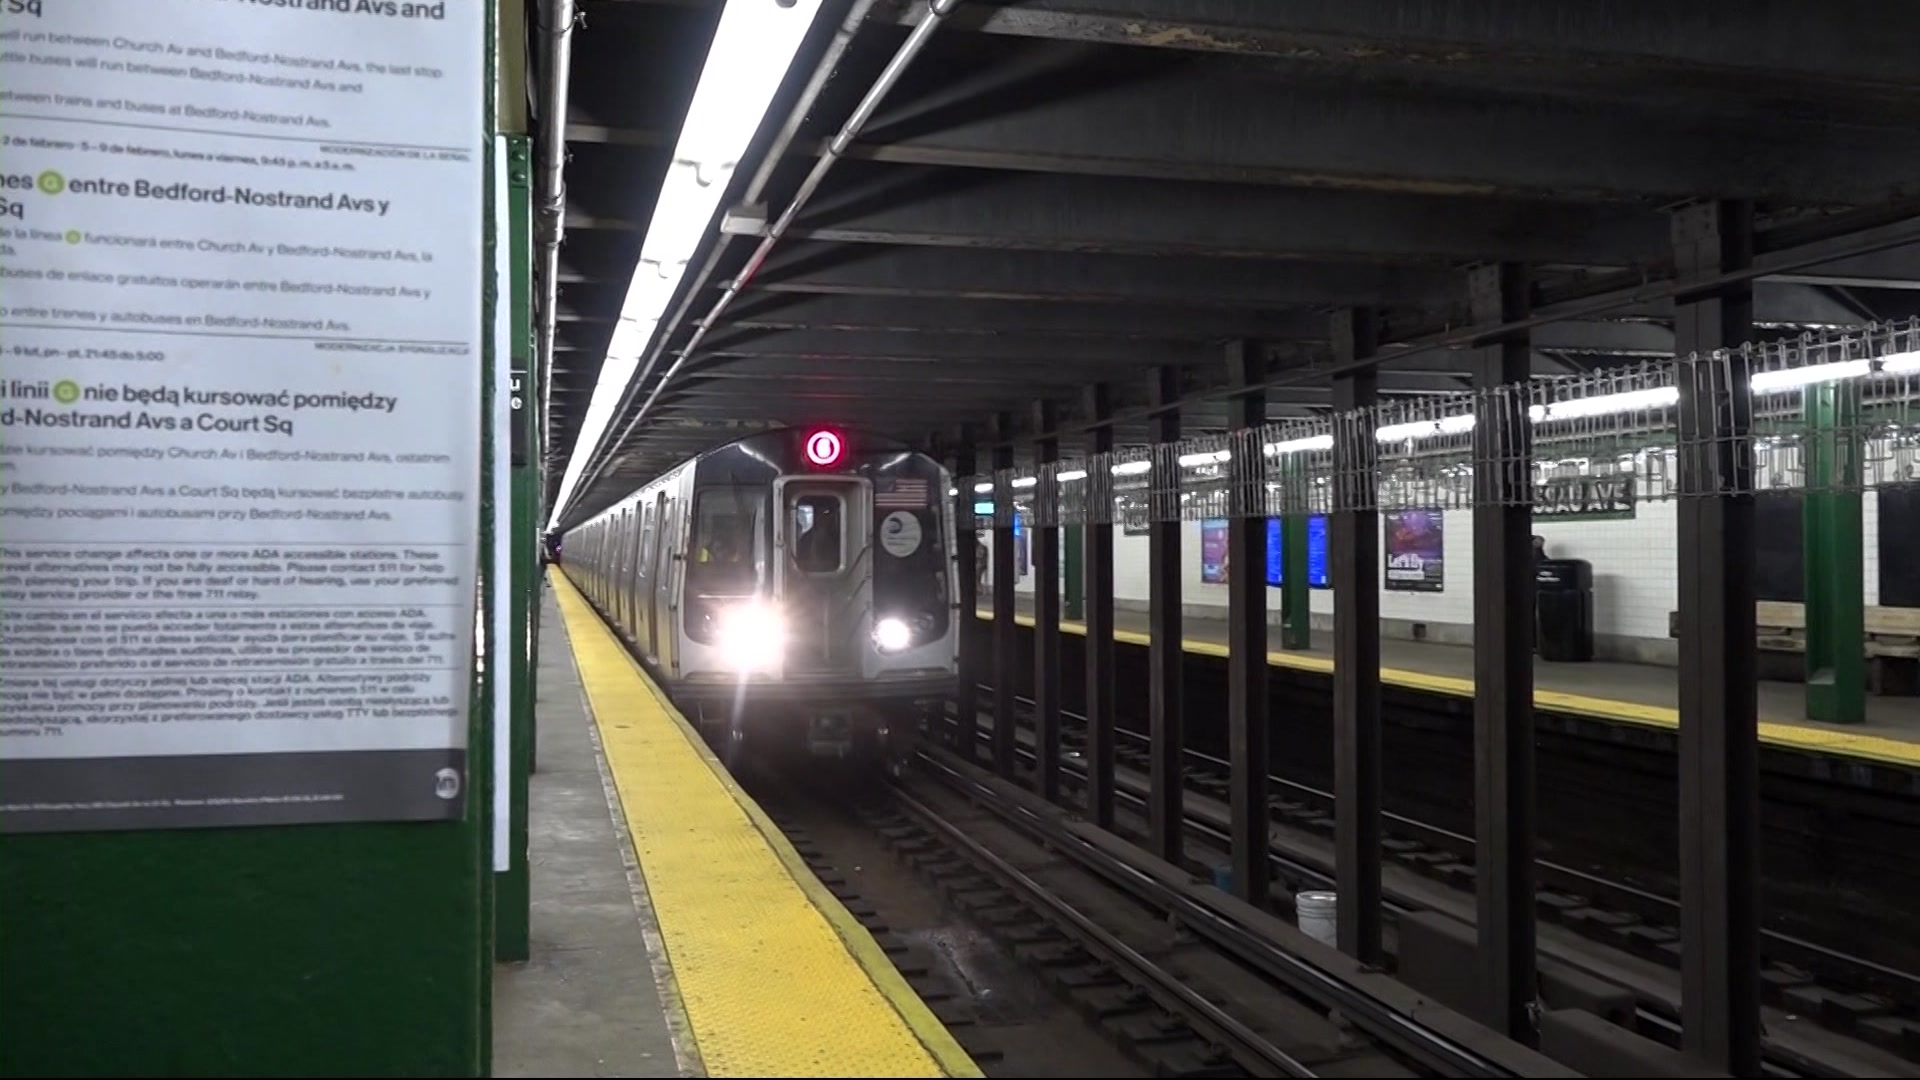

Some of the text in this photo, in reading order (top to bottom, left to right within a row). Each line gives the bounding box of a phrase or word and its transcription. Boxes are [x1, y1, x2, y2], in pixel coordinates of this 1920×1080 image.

[8, 0, 43, 18] Sq
[355, 0, 397, 17] Avs
[400, 1, 445, 20] and
[23, 32, 46, 42] run
[48, 32, 110, 48] between
[113, 37, 164, 53] Church
[167, 44, 184, 55] Av
[187, 47, 213, 58] and
[215, 47, 334, 71] Bedford-Nostrand
[366, 62, 387, 74] the
[389, 64, 411, 75] last
[414, 65, 444, 79] stop
[29, 54, 363, 93] buses will run between Bedford-Nostrand Avs and
[55, 94, 93, 107] trains
[96, 98, 122, 110] and
[125, 100, 165, 114] buses
[168, 105, 182, 115] at
[184, 104, 303, 127] Bedford-Nostrand
[0, 174, 33, 191] es
[69, 178, 130, 197] entre
[134, 179, 334, 211] Bedford-Nostrand
[336, 194, 374, 213] Avs
[378, 200, 390, 216] y
[15, 229, 27, 239] la
[30, 229, 62, 242] línea
[84, 233, 157, 248] funcionará
[159, 240, 194, 251] entre
[197, 239, 245, 254] Church
[248, 244, 264, 254] Av
[267, 247, 273, 256] y
[277, 244, 391, 261] Bedford-Nostrand
[421, 251, 432, 263] la
[46, 269, 431, 300] de enlace gratuitos operarán entre Bedford-Nostrand Avs y
[11, 307, 48, 319] entre
[52, 308, 96, 321] trenes
[99, 313, 106, 323] y
[110, 312, 182, 325] autobuses
[186, 316, 201, 326] en
[205, 315, 323, 331] Bedford-Nostrand
[11, 380, 49, 400] linii
[84, 383, 118, 402] nie
[123, 384, 179, 407] będą
[184, 386, 290, 407] kursować
[294, 391, 397, 413] pomiędzy
[0, 407, 293, 437] d-Nostrand Avs a Court Sq
[26, 445, 93, 457] kursować
[97, 447, 163, 460] pomiędzy
[167, 447, 217, 459] Church
[220, 449, 237, 460] Av
[247, 449, 363, 463] Bedford-Nostrand
[395, 454, 450, 464] ostatnim
[11, 482, 464, 501] Bedford-Nostrand Avs a Court Sq będą kursować bezpłatne autobusy
[57, 507, 128, 519] pociągami
[137, 508, 215, 518] autobusami
[217, 511, 246, 521] przy
[249, 508, 366, 520] Bedford-Nostrand
[26, 550, 71, 559] service
[74, 551, 122, 561] change
[126, 549, 169, 559] affects
[173, 551, 196, 559] one
[200, 551, 213, 559] or
[216, 551, 249, 560] more
[252, 549, 279, 559] ADA
[283, 550, 346, 560] accessible
[404, 549, 438, 560] These
